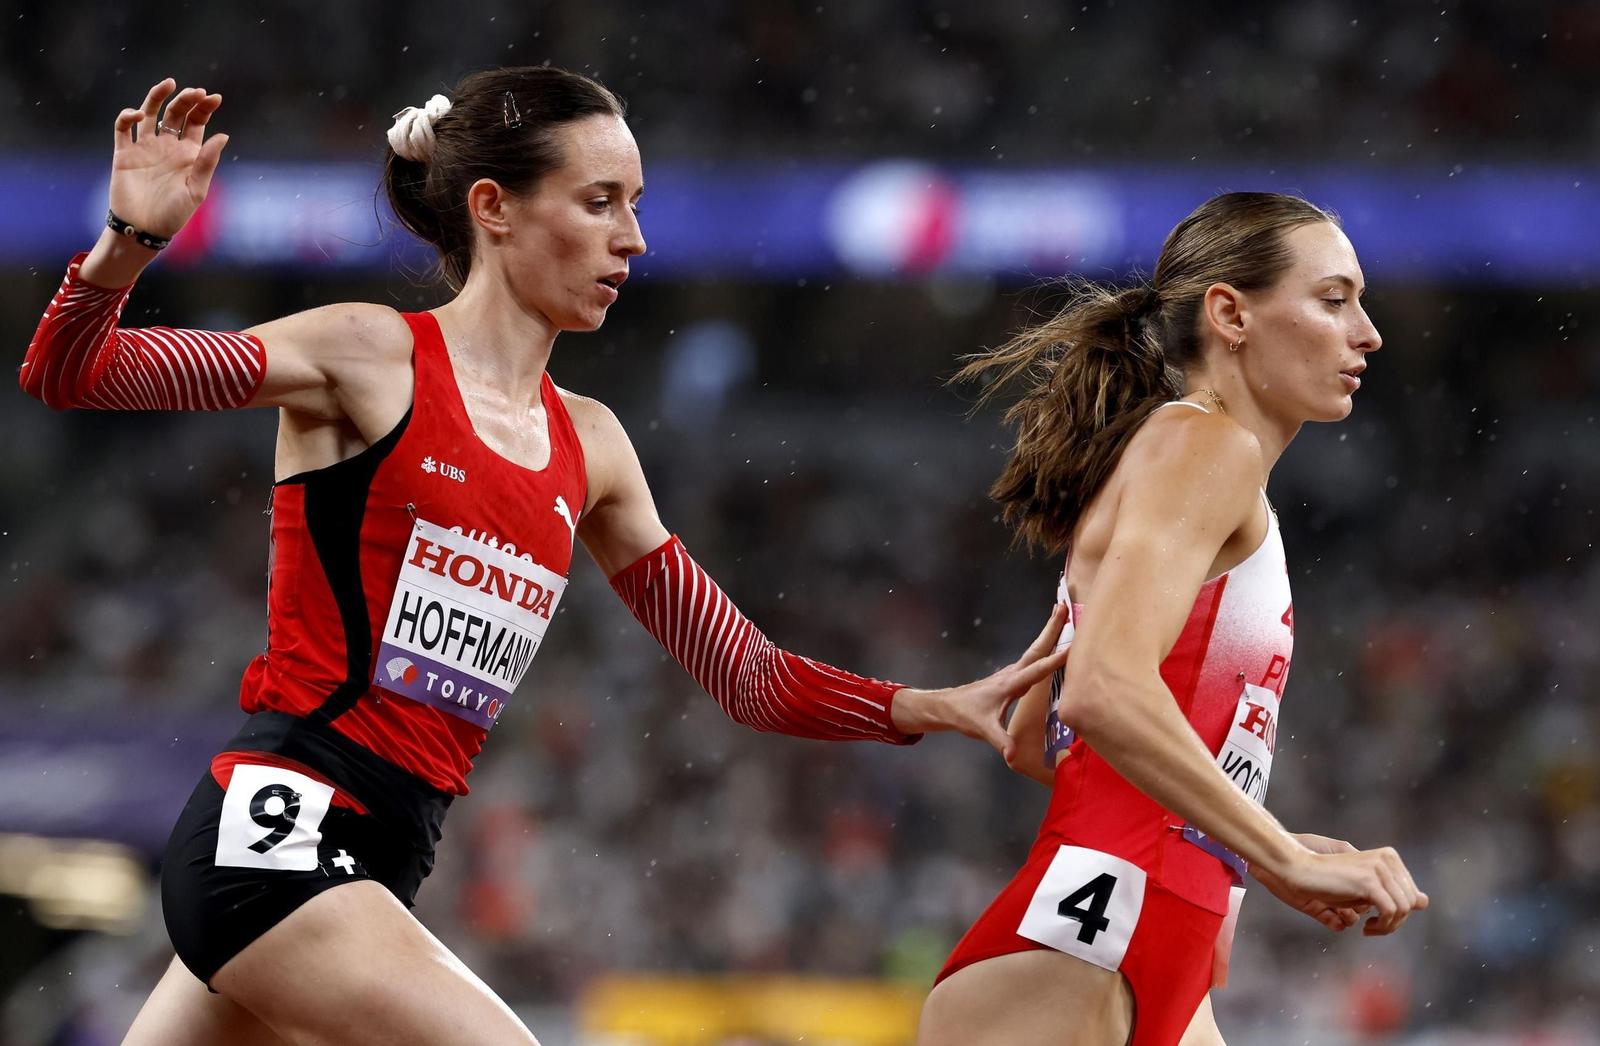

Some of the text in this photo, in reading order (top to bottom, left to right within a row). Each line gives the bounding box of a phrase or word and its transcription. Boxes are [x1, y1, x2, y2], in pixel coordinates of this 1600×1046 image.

[440, 462, 466, 483] UBS
[408, 536, 555, 620] HONDA
[393, 590, 537, 686] HOFFMANN
[247, 783, 301, 855] 9
[1057, 872, 1118, 946] 4
